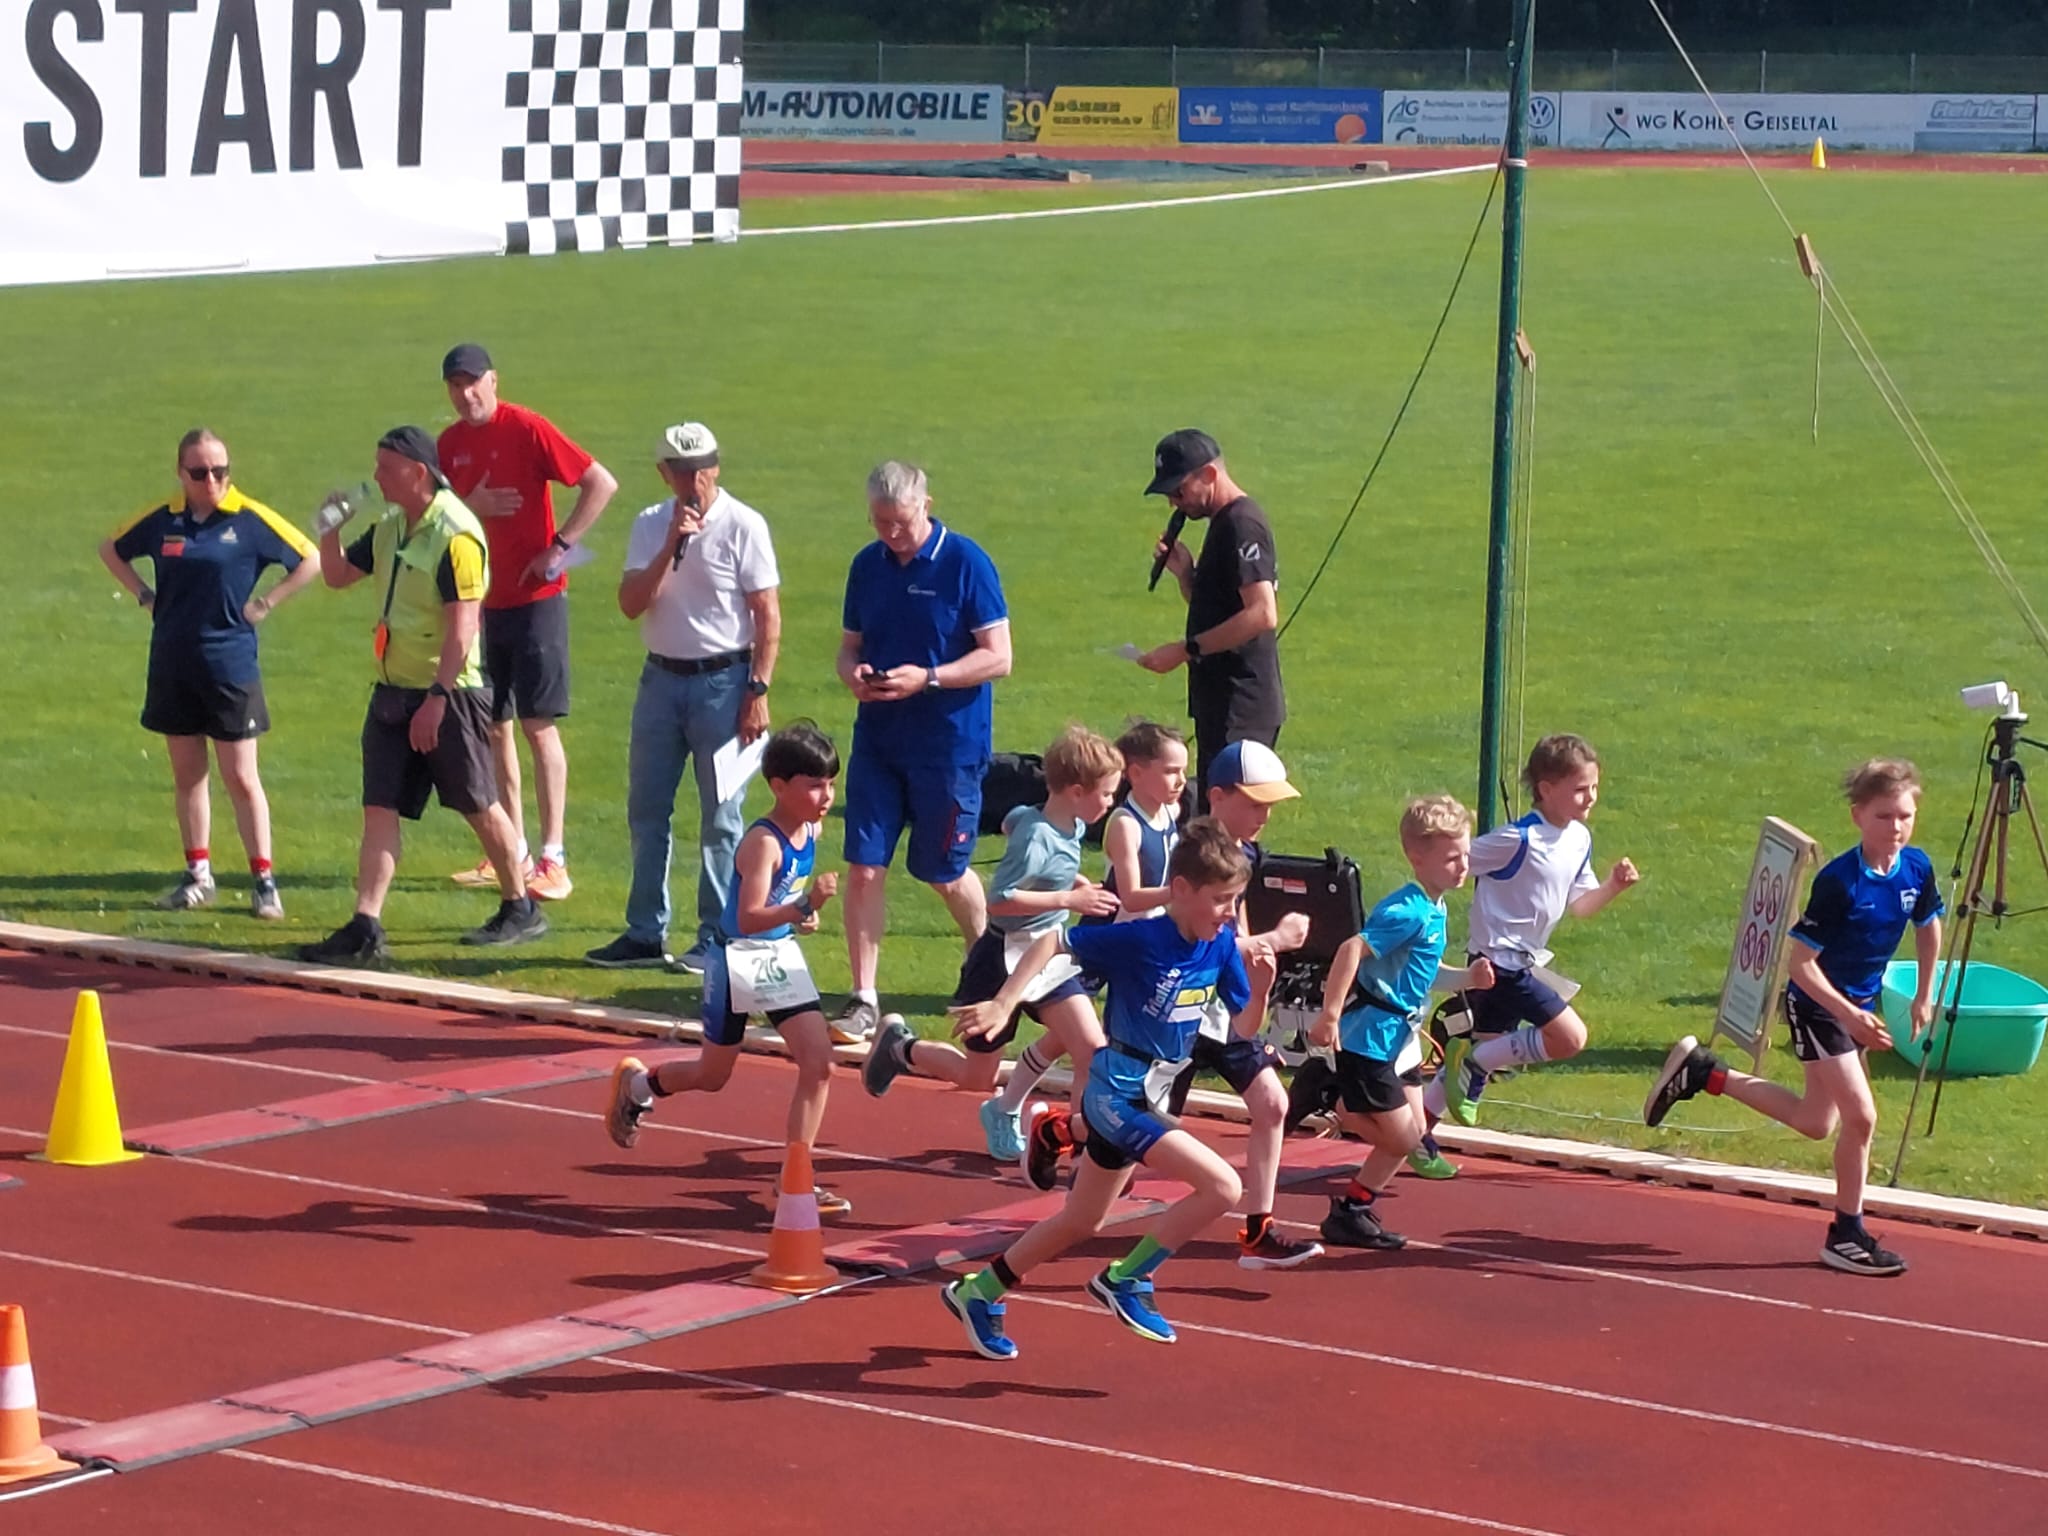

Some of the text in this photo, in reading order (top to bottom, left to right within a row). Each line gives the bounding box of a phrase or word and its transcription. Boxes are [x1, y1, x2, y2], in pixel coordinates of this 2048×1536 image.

[24, 0, 452, 184] START
[1006, 100, 1046, 128] 30
[1637, 109, 1838, 131] WG KOHLE GEISELTAL
